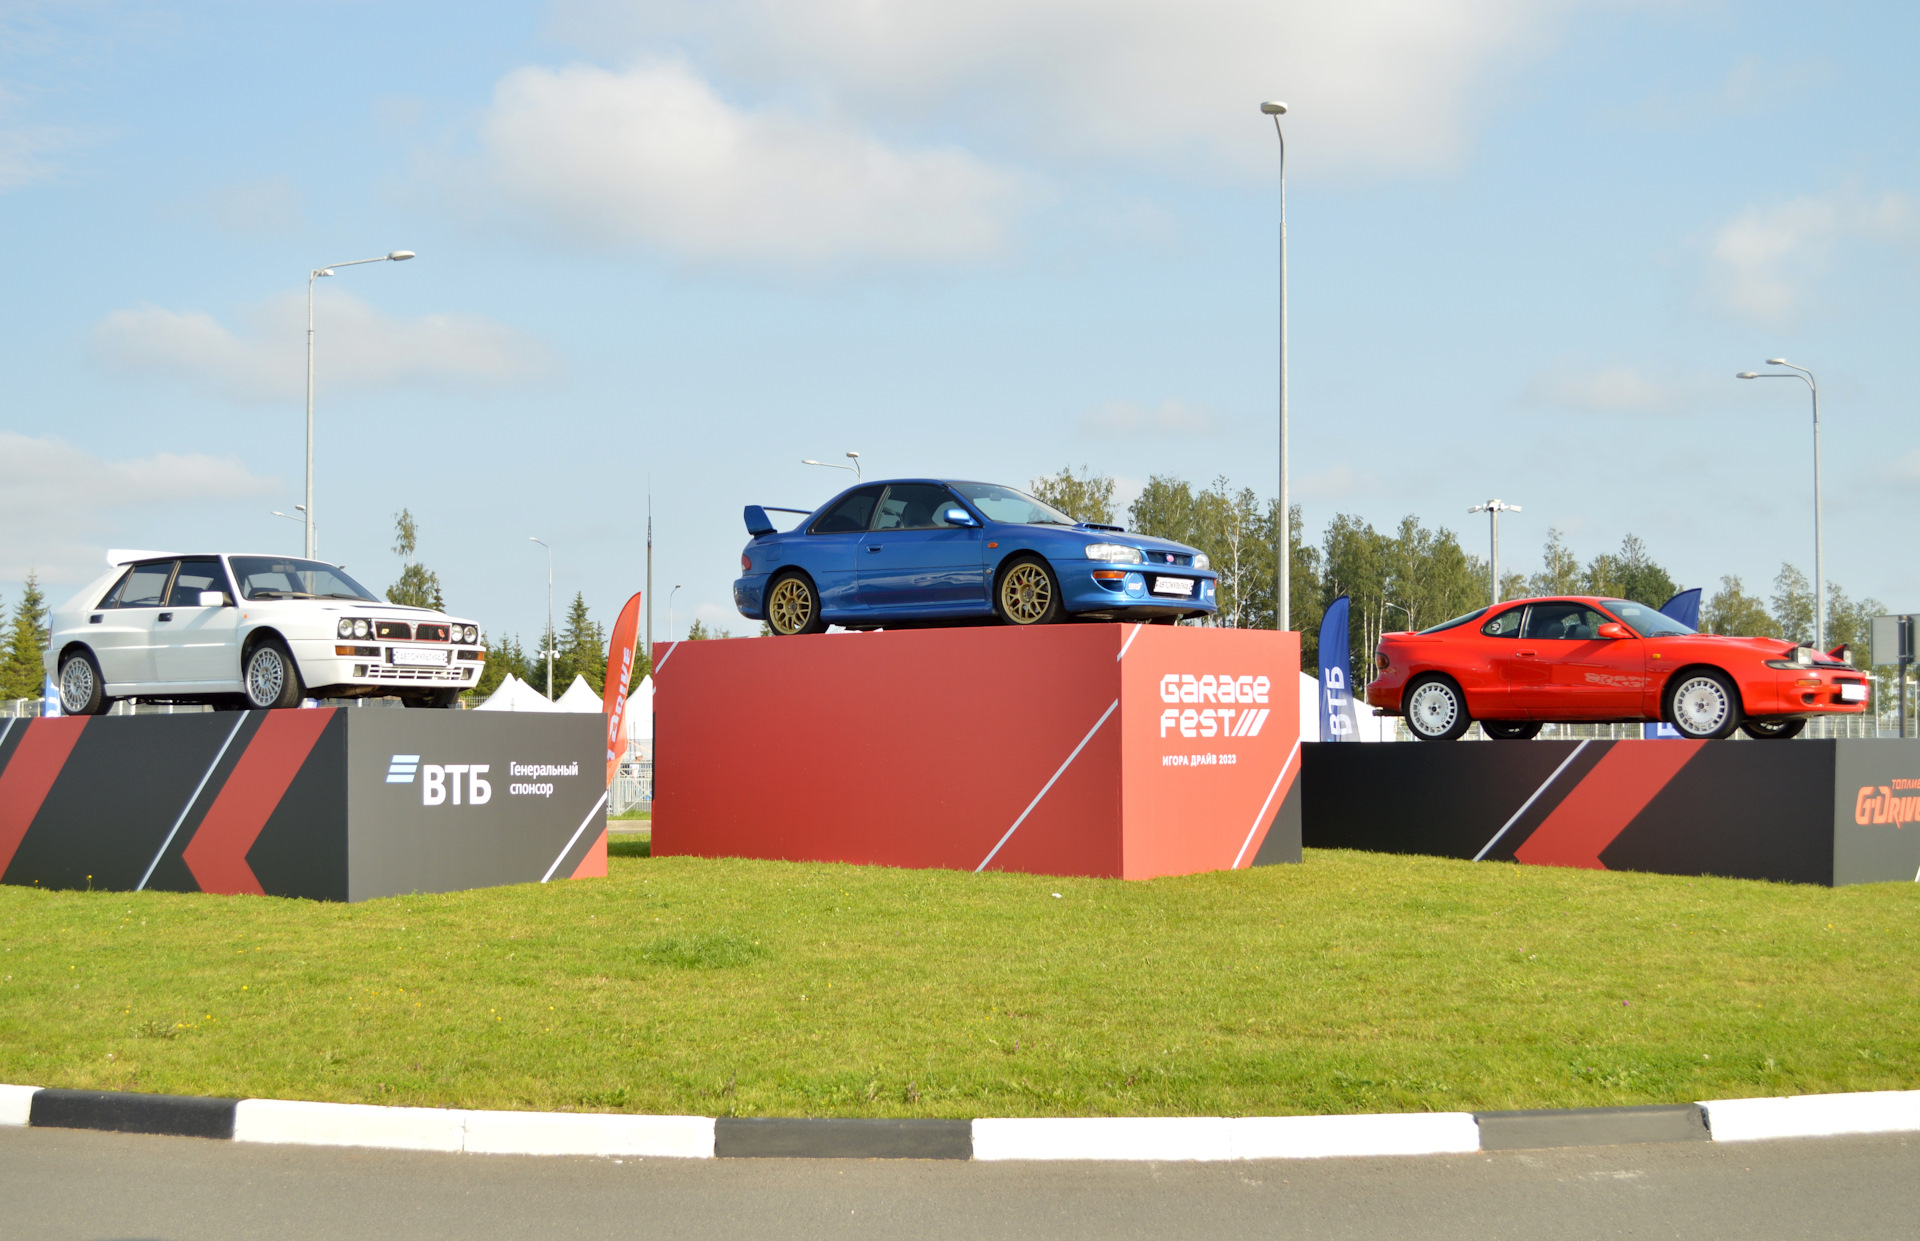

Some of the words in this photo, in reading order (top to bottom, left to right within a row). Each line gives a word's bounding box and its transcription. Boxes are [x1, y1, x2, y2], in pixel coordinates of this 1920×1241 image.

[1325, 666, 1352, 735] ВТБ
[1162, 755, 1189, 766] ИГОРА
[1190, 753, 1217, 767] ДРАЙВ
[1219, 754, 1237, 764] 2023
[510, 761, 578, 779] Генеральный
[423, 764, 492, 806] ВТБ
[510, 783, 553, 797] спонсор
